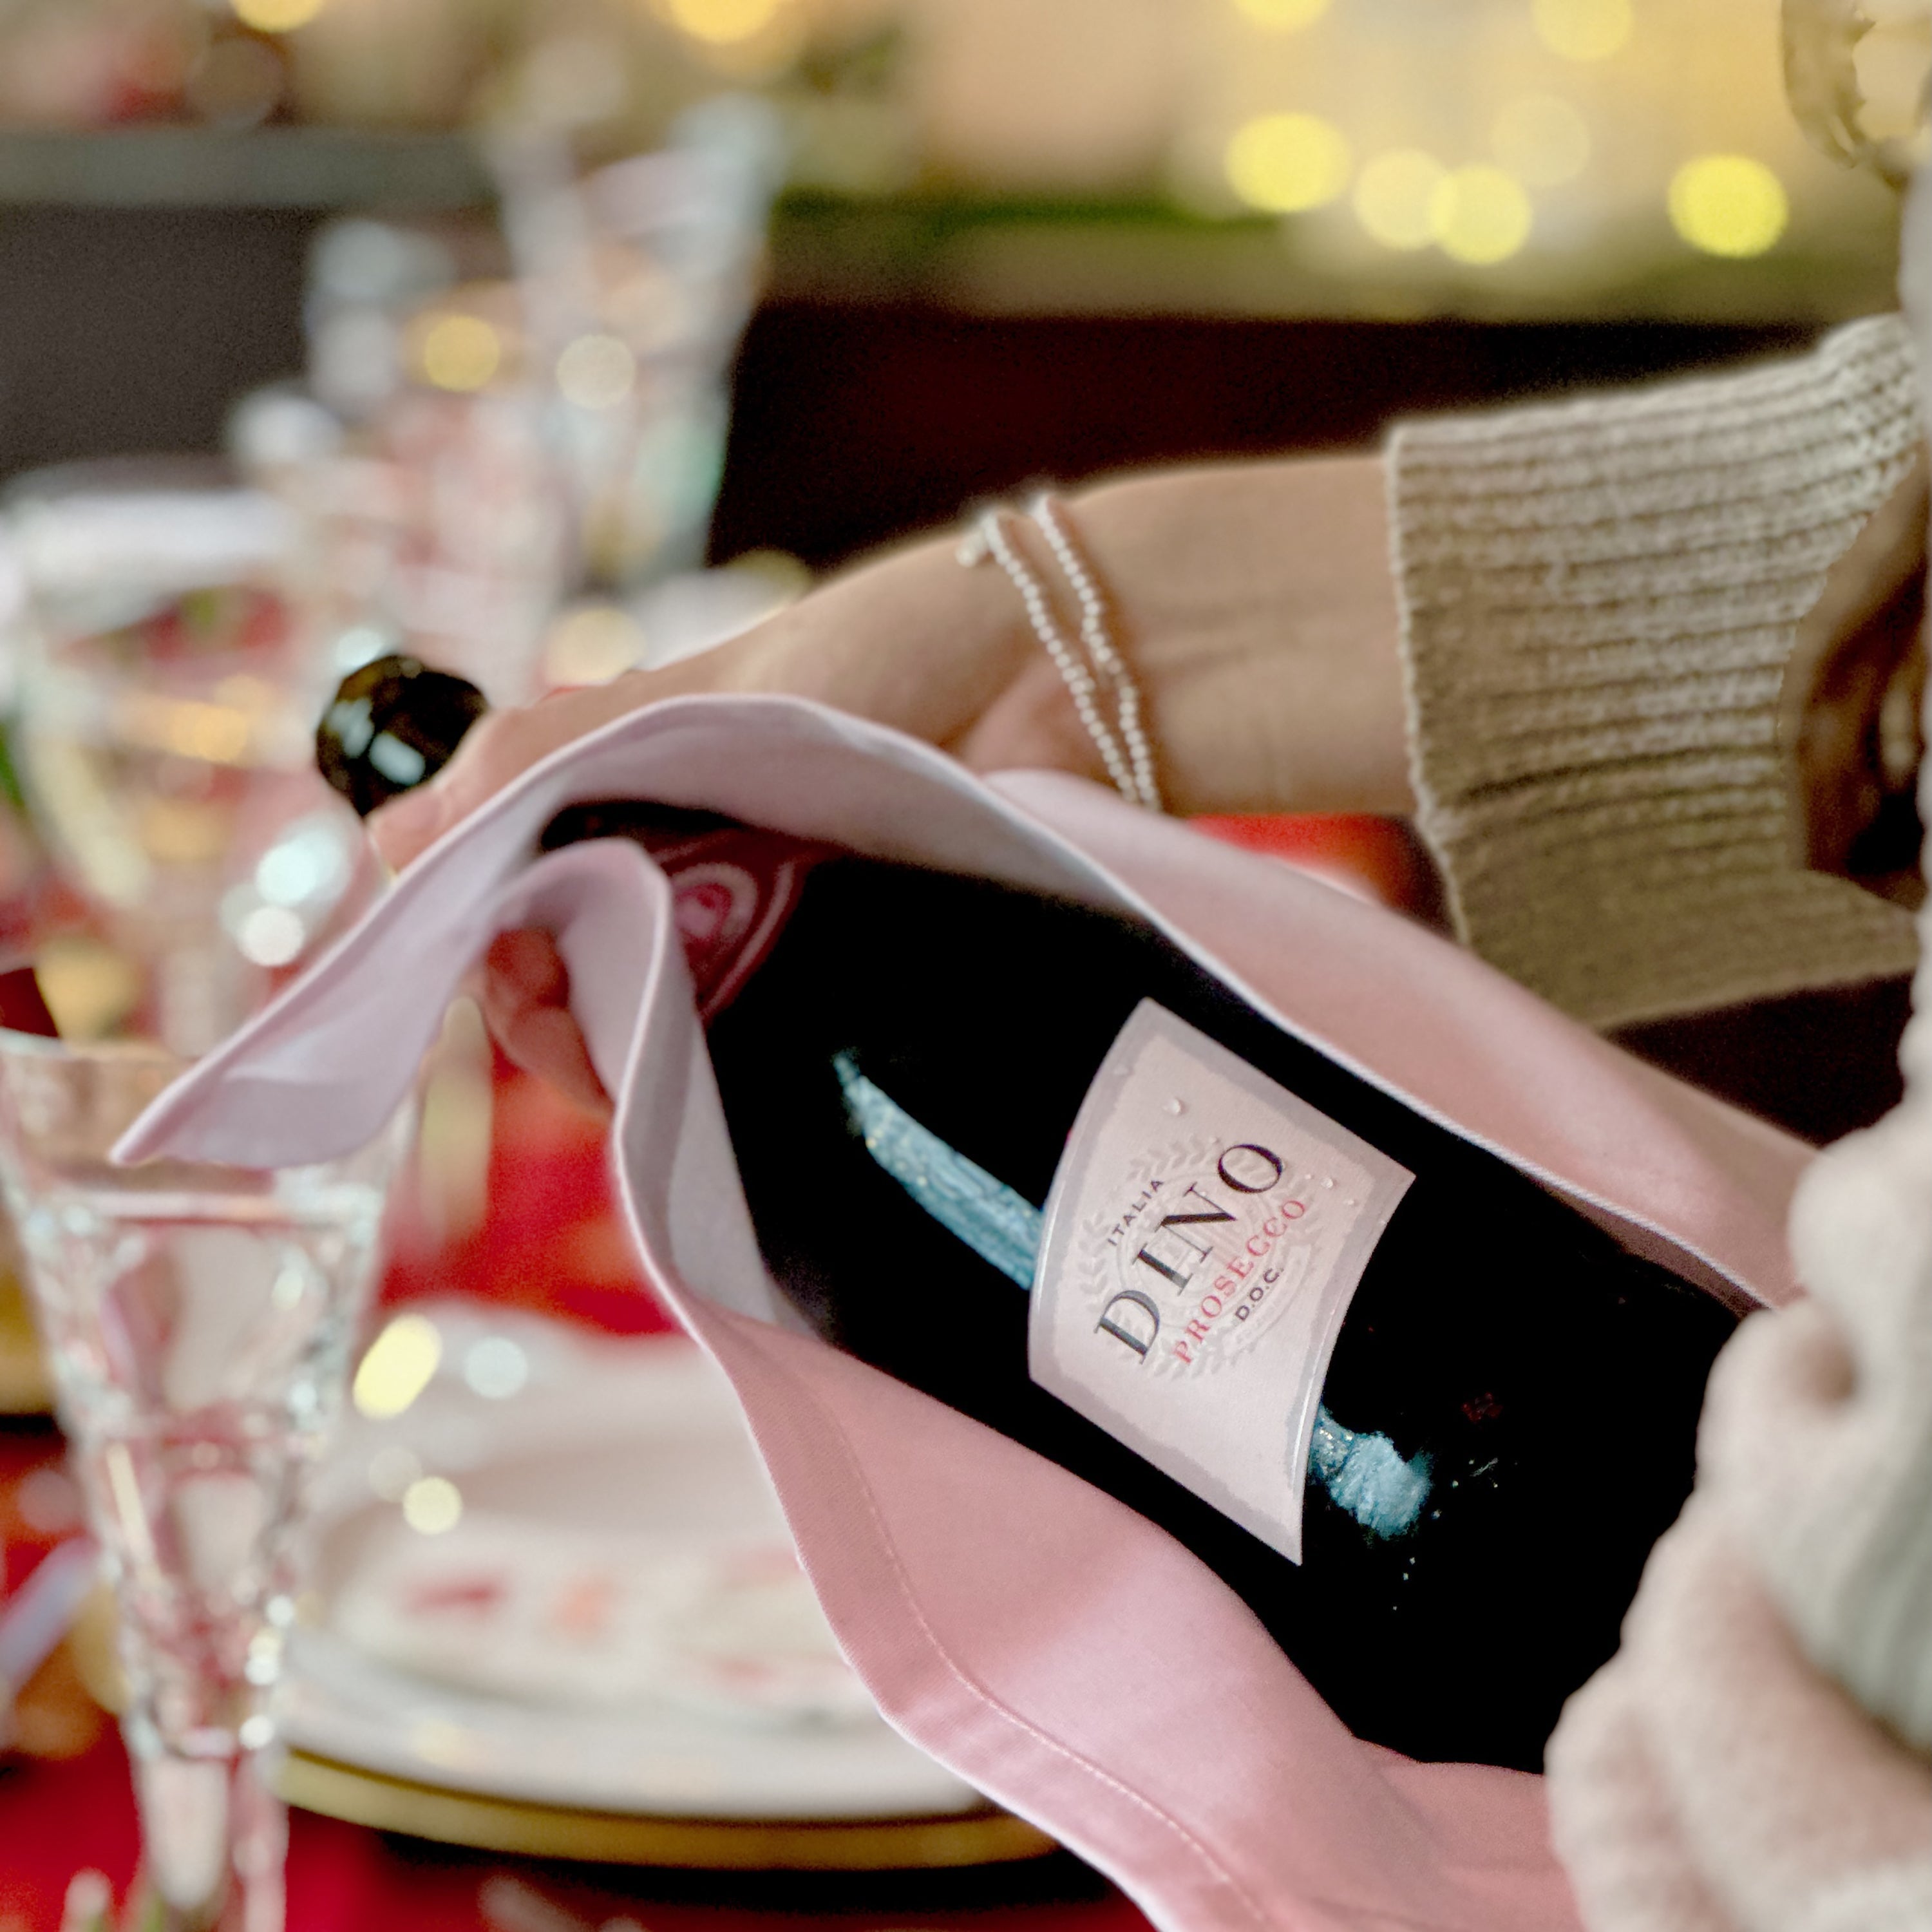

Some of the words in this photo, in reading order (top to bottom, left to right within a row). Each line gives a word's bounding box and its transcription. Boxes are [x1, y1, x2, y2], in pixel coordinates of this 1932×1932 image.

[1094, 1144, 1283, 1365] DINO
[1107, 1179, 1164, 1246] ITALIA
[1172, 1200, 1305, 1364] PROSECCO
[1235, 1267, 1284, 1321] D.O.C.
